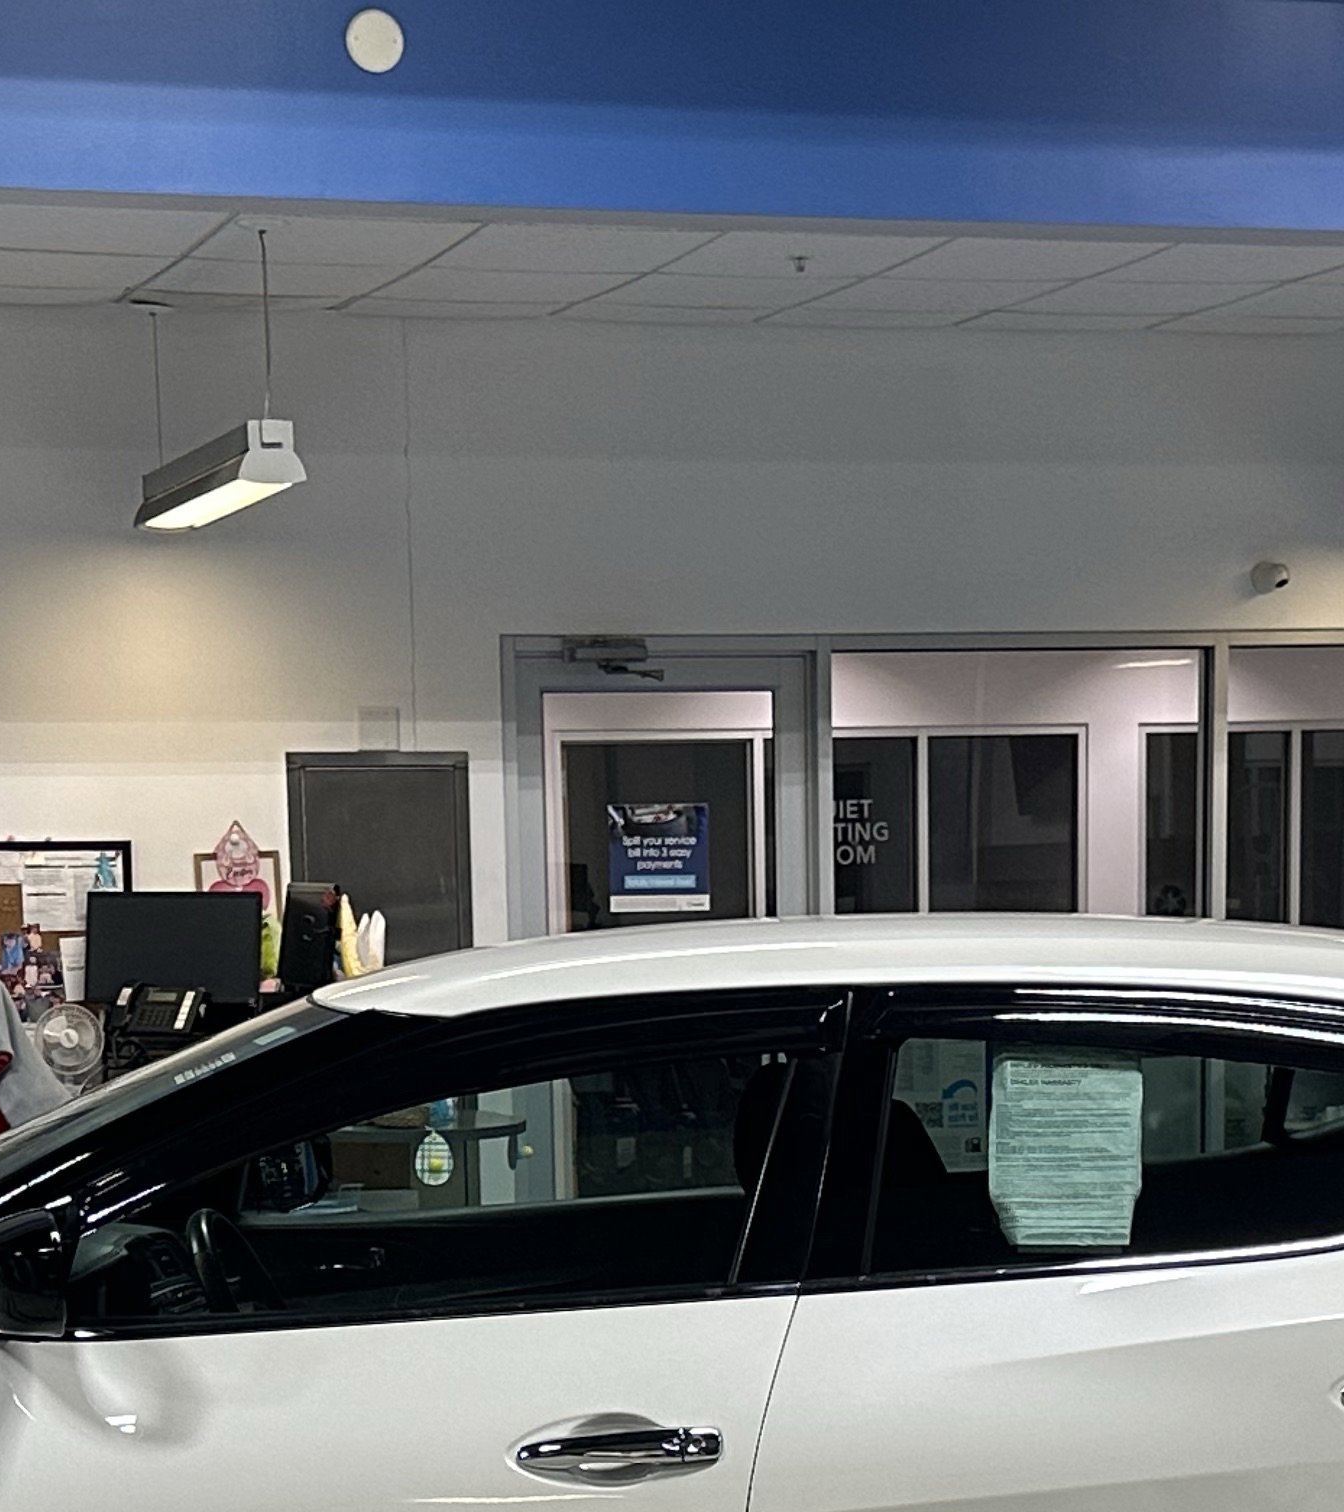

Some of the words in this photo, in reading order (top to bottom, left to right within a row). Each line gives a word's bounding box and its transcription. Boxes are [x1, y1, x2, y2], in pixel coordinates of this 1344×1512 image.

[834, 822, 889, 842] TING
[642, 836, 662, 847] your
[663, 836, 698, 846] service
[627, 847, 641, 858] bill
[642, 847, 660, 858] into
[669, 849, 692, 859] easy
[836, 845, 876, 865] OM
[636, 860, 683, 871] payments
